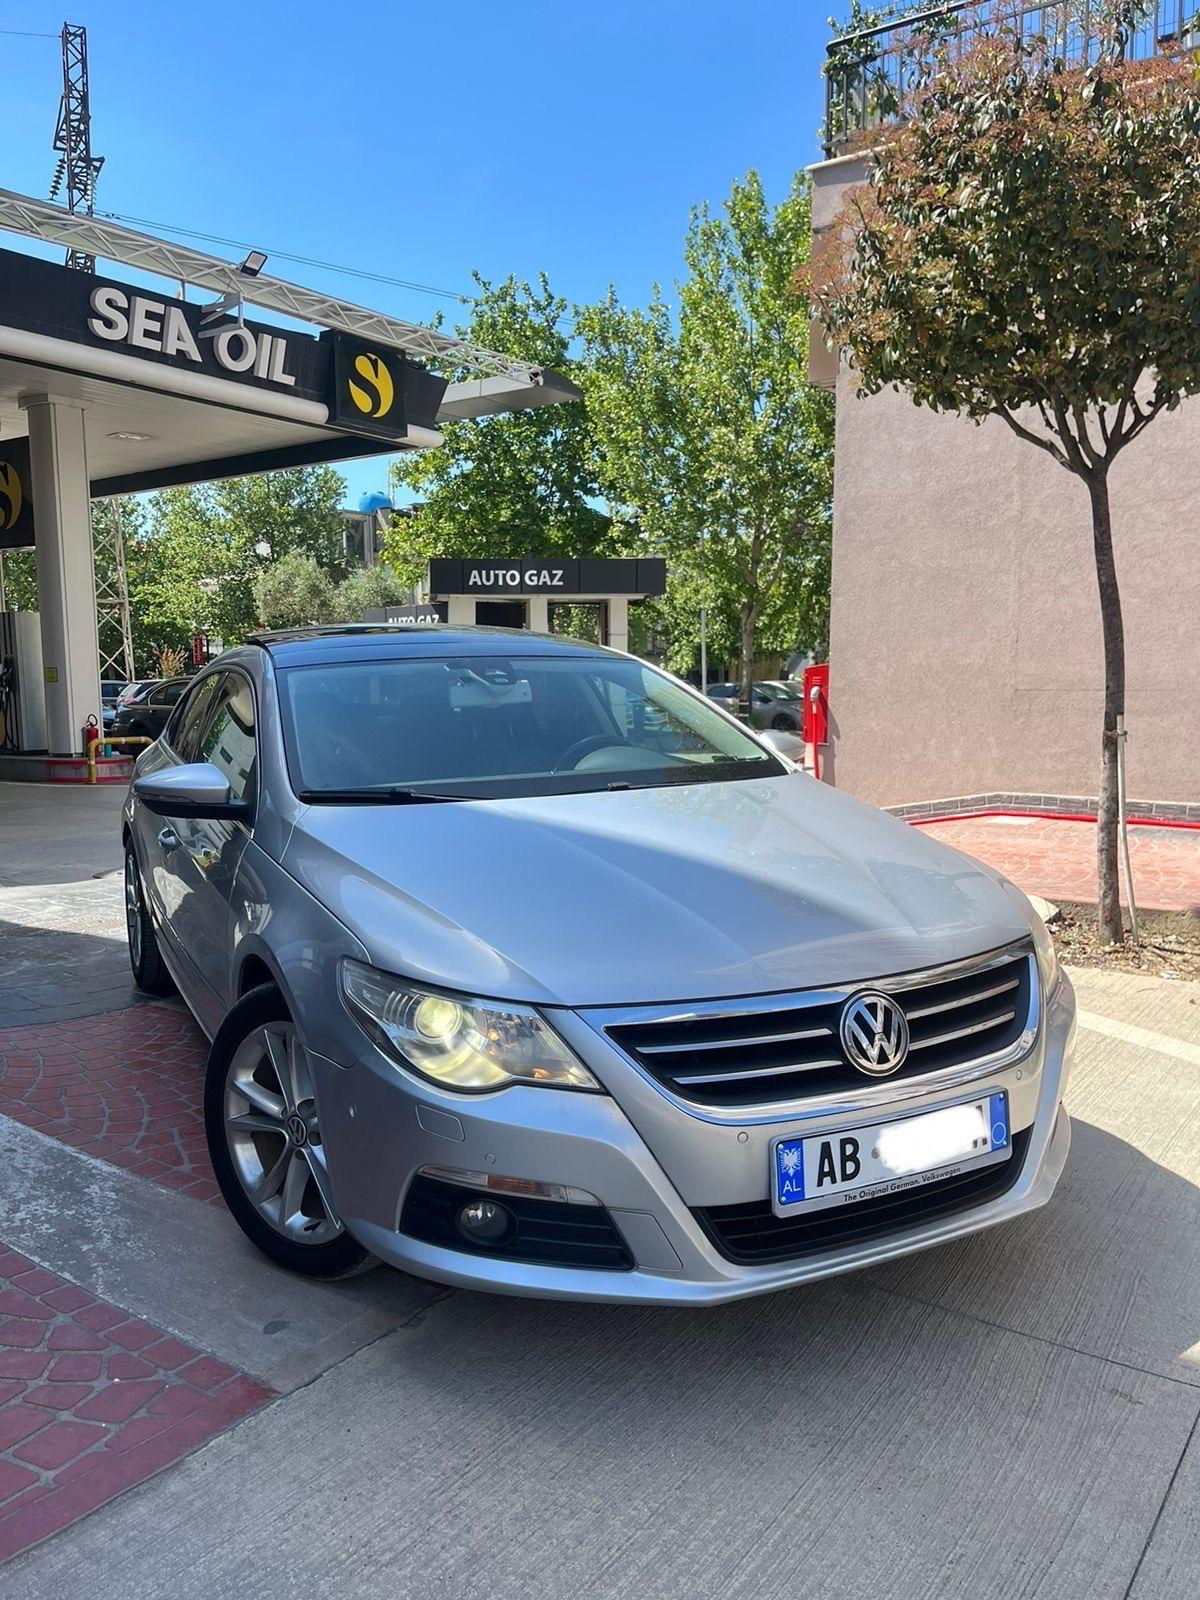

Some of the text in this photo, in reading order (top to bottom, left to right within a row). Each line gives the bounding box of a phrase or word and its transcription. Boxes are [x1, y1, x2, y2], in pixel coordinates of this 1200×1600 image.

[87, 287, 296, 386] SEA OIL
[468, 569, 564, 586] AUTO GAZ
[842, 993, 907, 1072] VW
[816, 1136, 861, 1188] AB
[782, 1179, 802, 1194] AL
[844, 1194, 857, 1203] The
[859, 1184, 889, 1199] Original
[921, 1167, 961, 1183] Volkswagen
